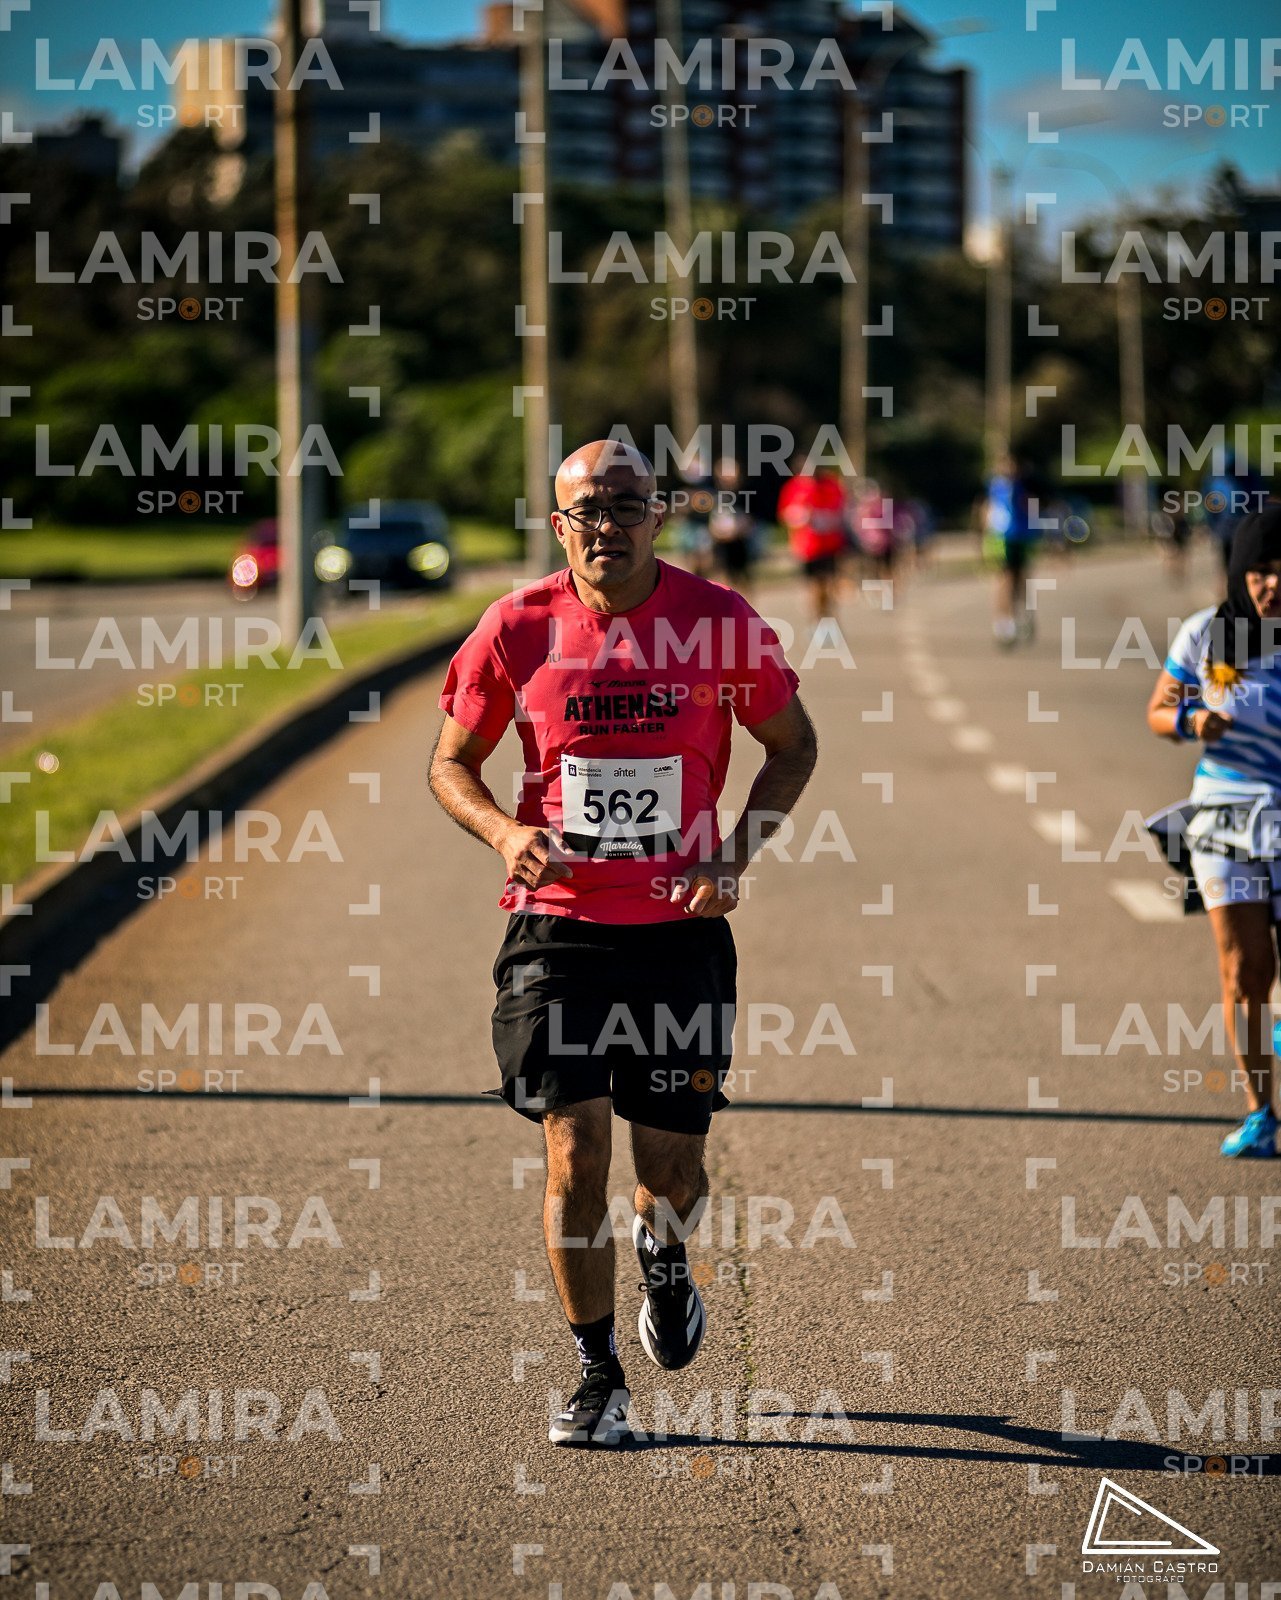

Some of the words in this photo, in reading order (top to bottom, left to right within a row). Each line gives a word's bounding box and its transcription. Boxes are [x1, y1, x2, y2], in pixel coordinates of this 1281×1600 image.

[563, 692, 679, 722] ATHENAS
[579, 725, 609, 736] RUN
[613, 723, 665, 734] FASTER
[613, 767, 636, 778] antel
[583, 788, 659, 826] 562
[600, 841, 644, 852] Maratón
